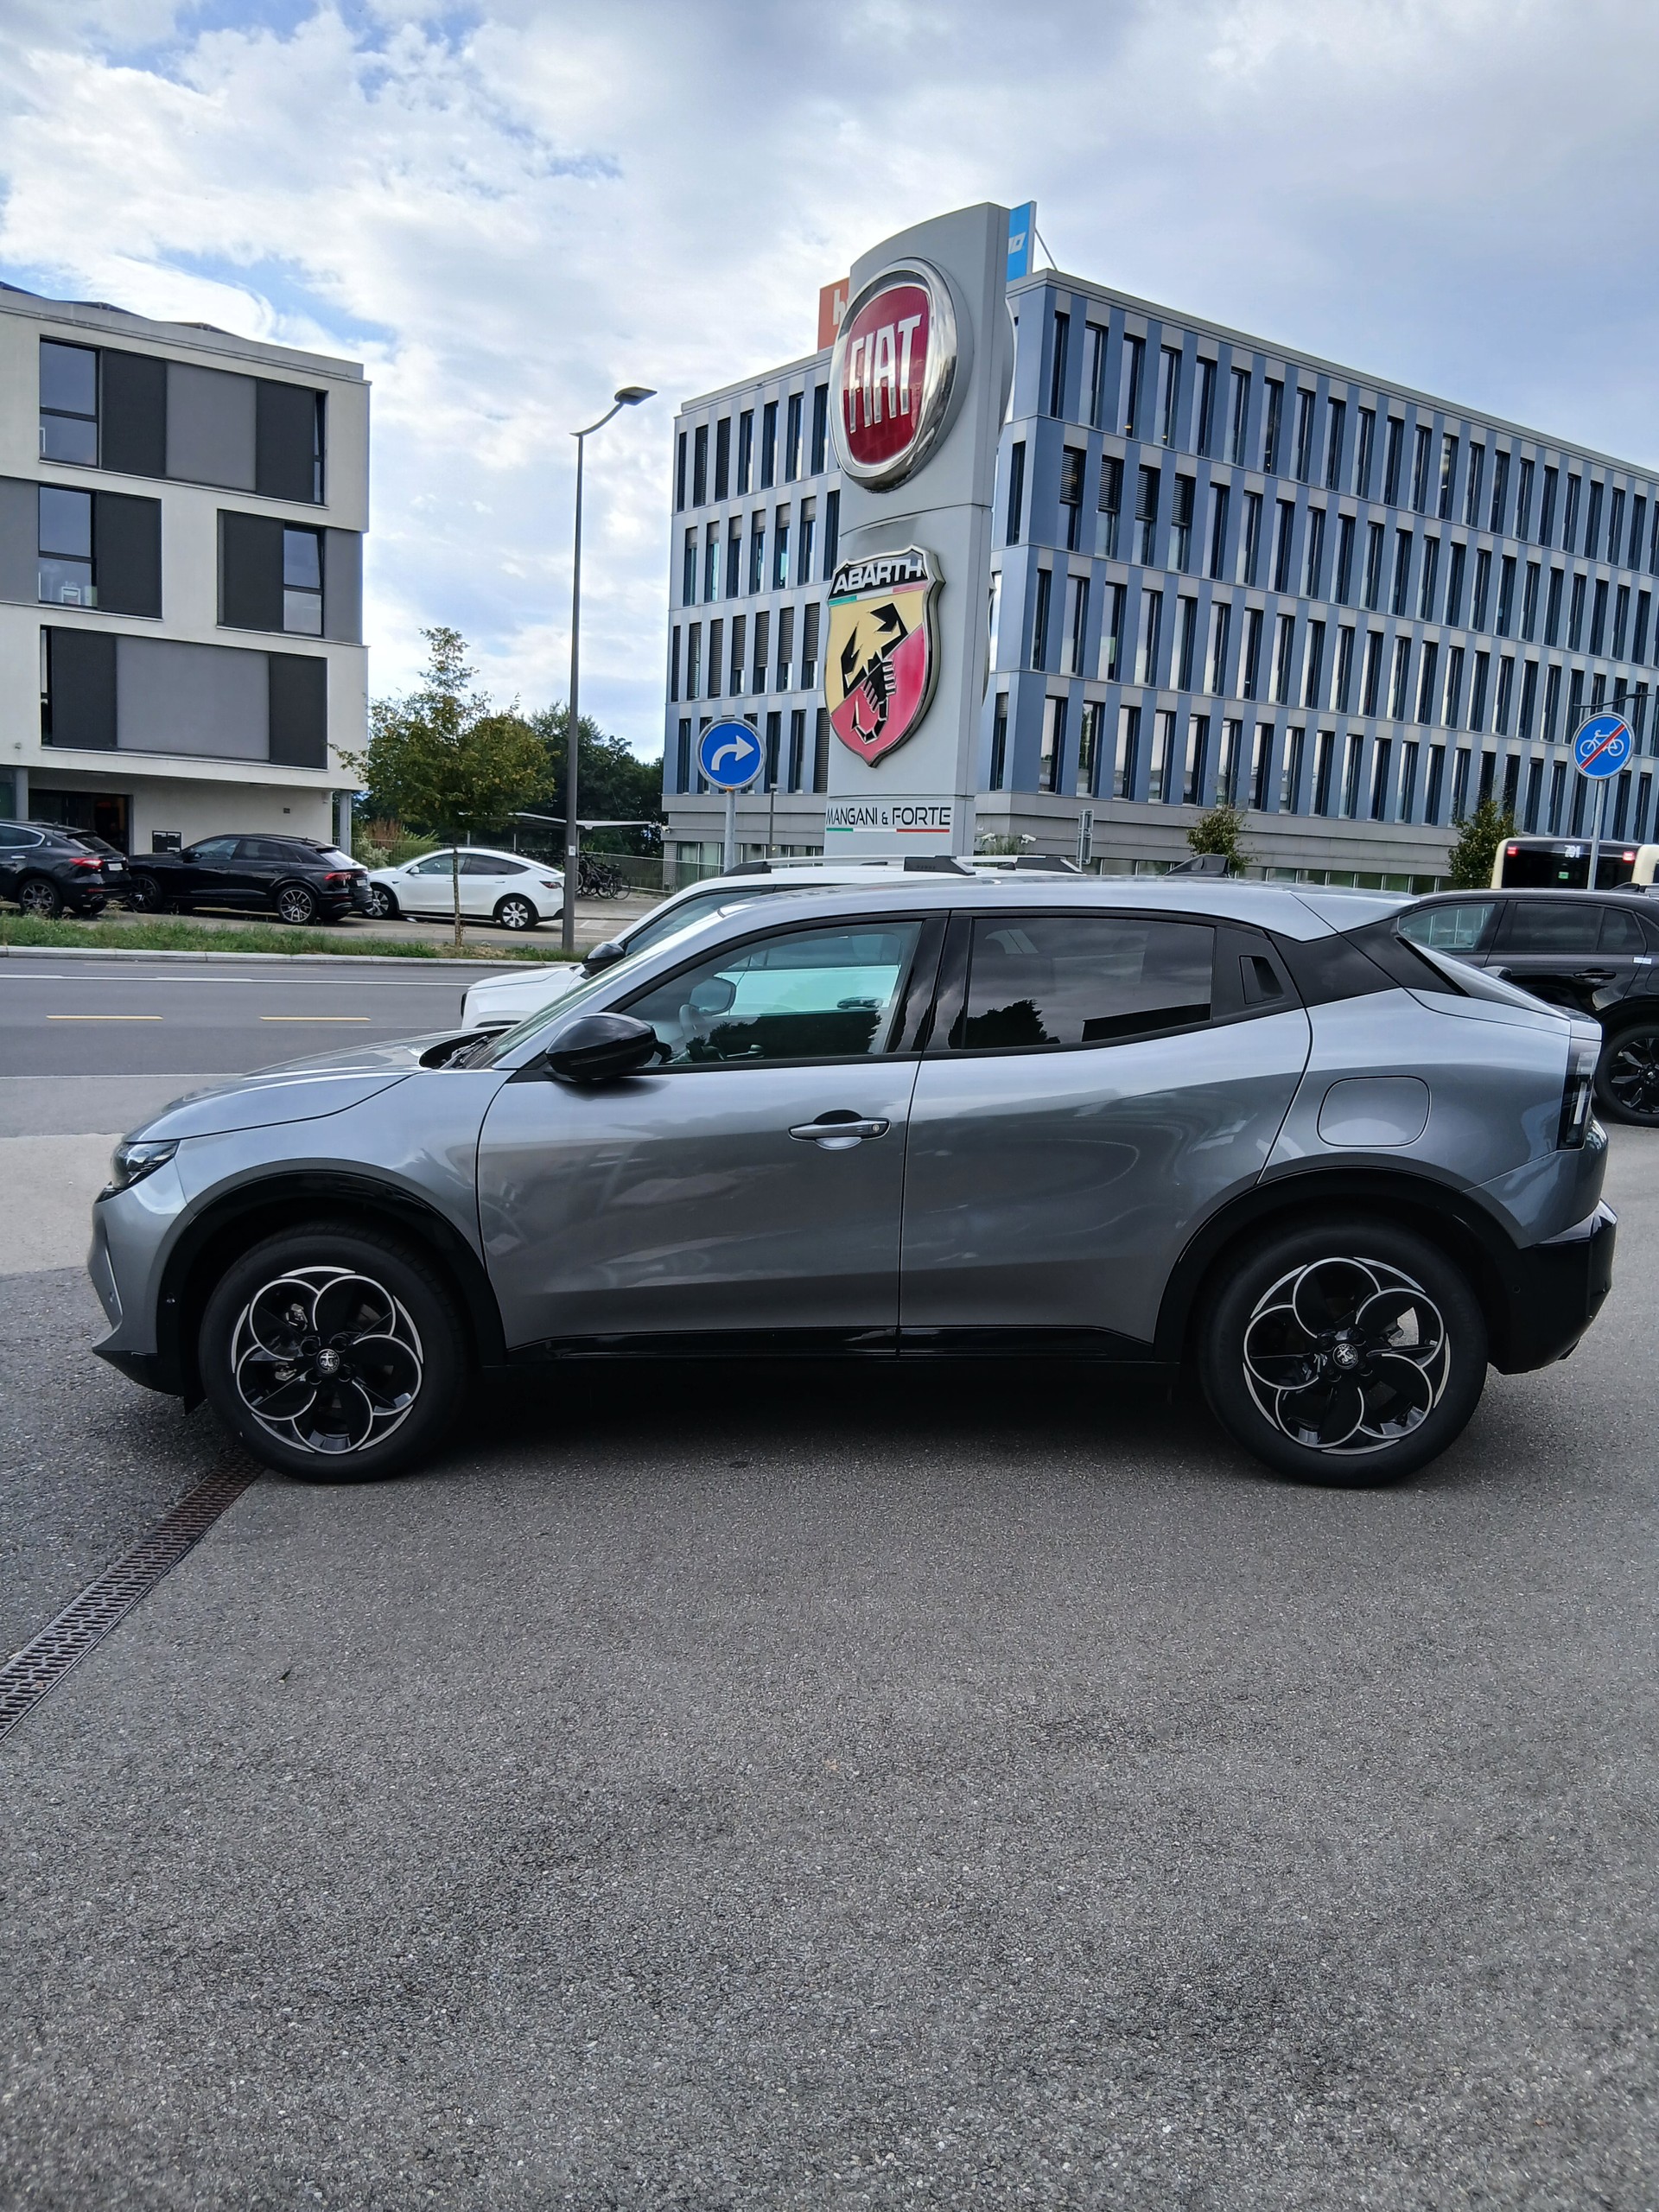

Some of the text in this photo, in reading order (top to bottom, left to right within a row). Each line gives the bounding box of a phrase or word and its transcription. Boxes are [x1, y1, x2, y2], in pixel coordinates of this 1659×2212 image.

[849, 314, 922, 434] FIAT
[832, 559, 923, 594] ABARTH
[826, 807, 951, 825] MANGANI & FORTE
